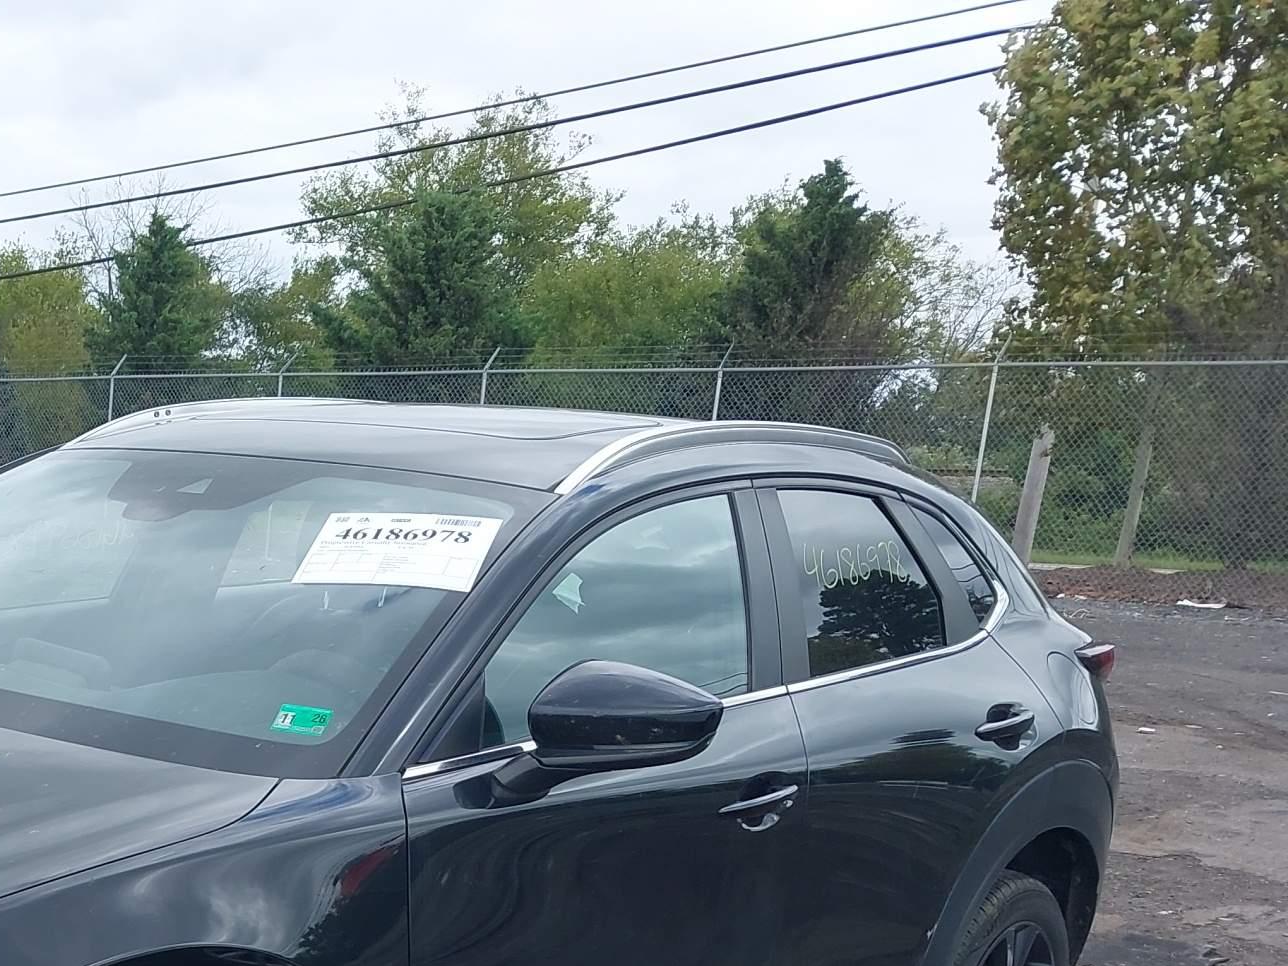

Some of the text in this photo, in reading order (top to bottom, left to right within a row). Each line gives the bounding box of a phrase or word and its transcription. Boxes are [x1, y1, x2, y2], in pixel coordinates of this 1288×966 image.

[335, 527, 473, 544] 46186978
[802, 540, 908, 589] 46186978
[281, 713, 296, 724] 11
